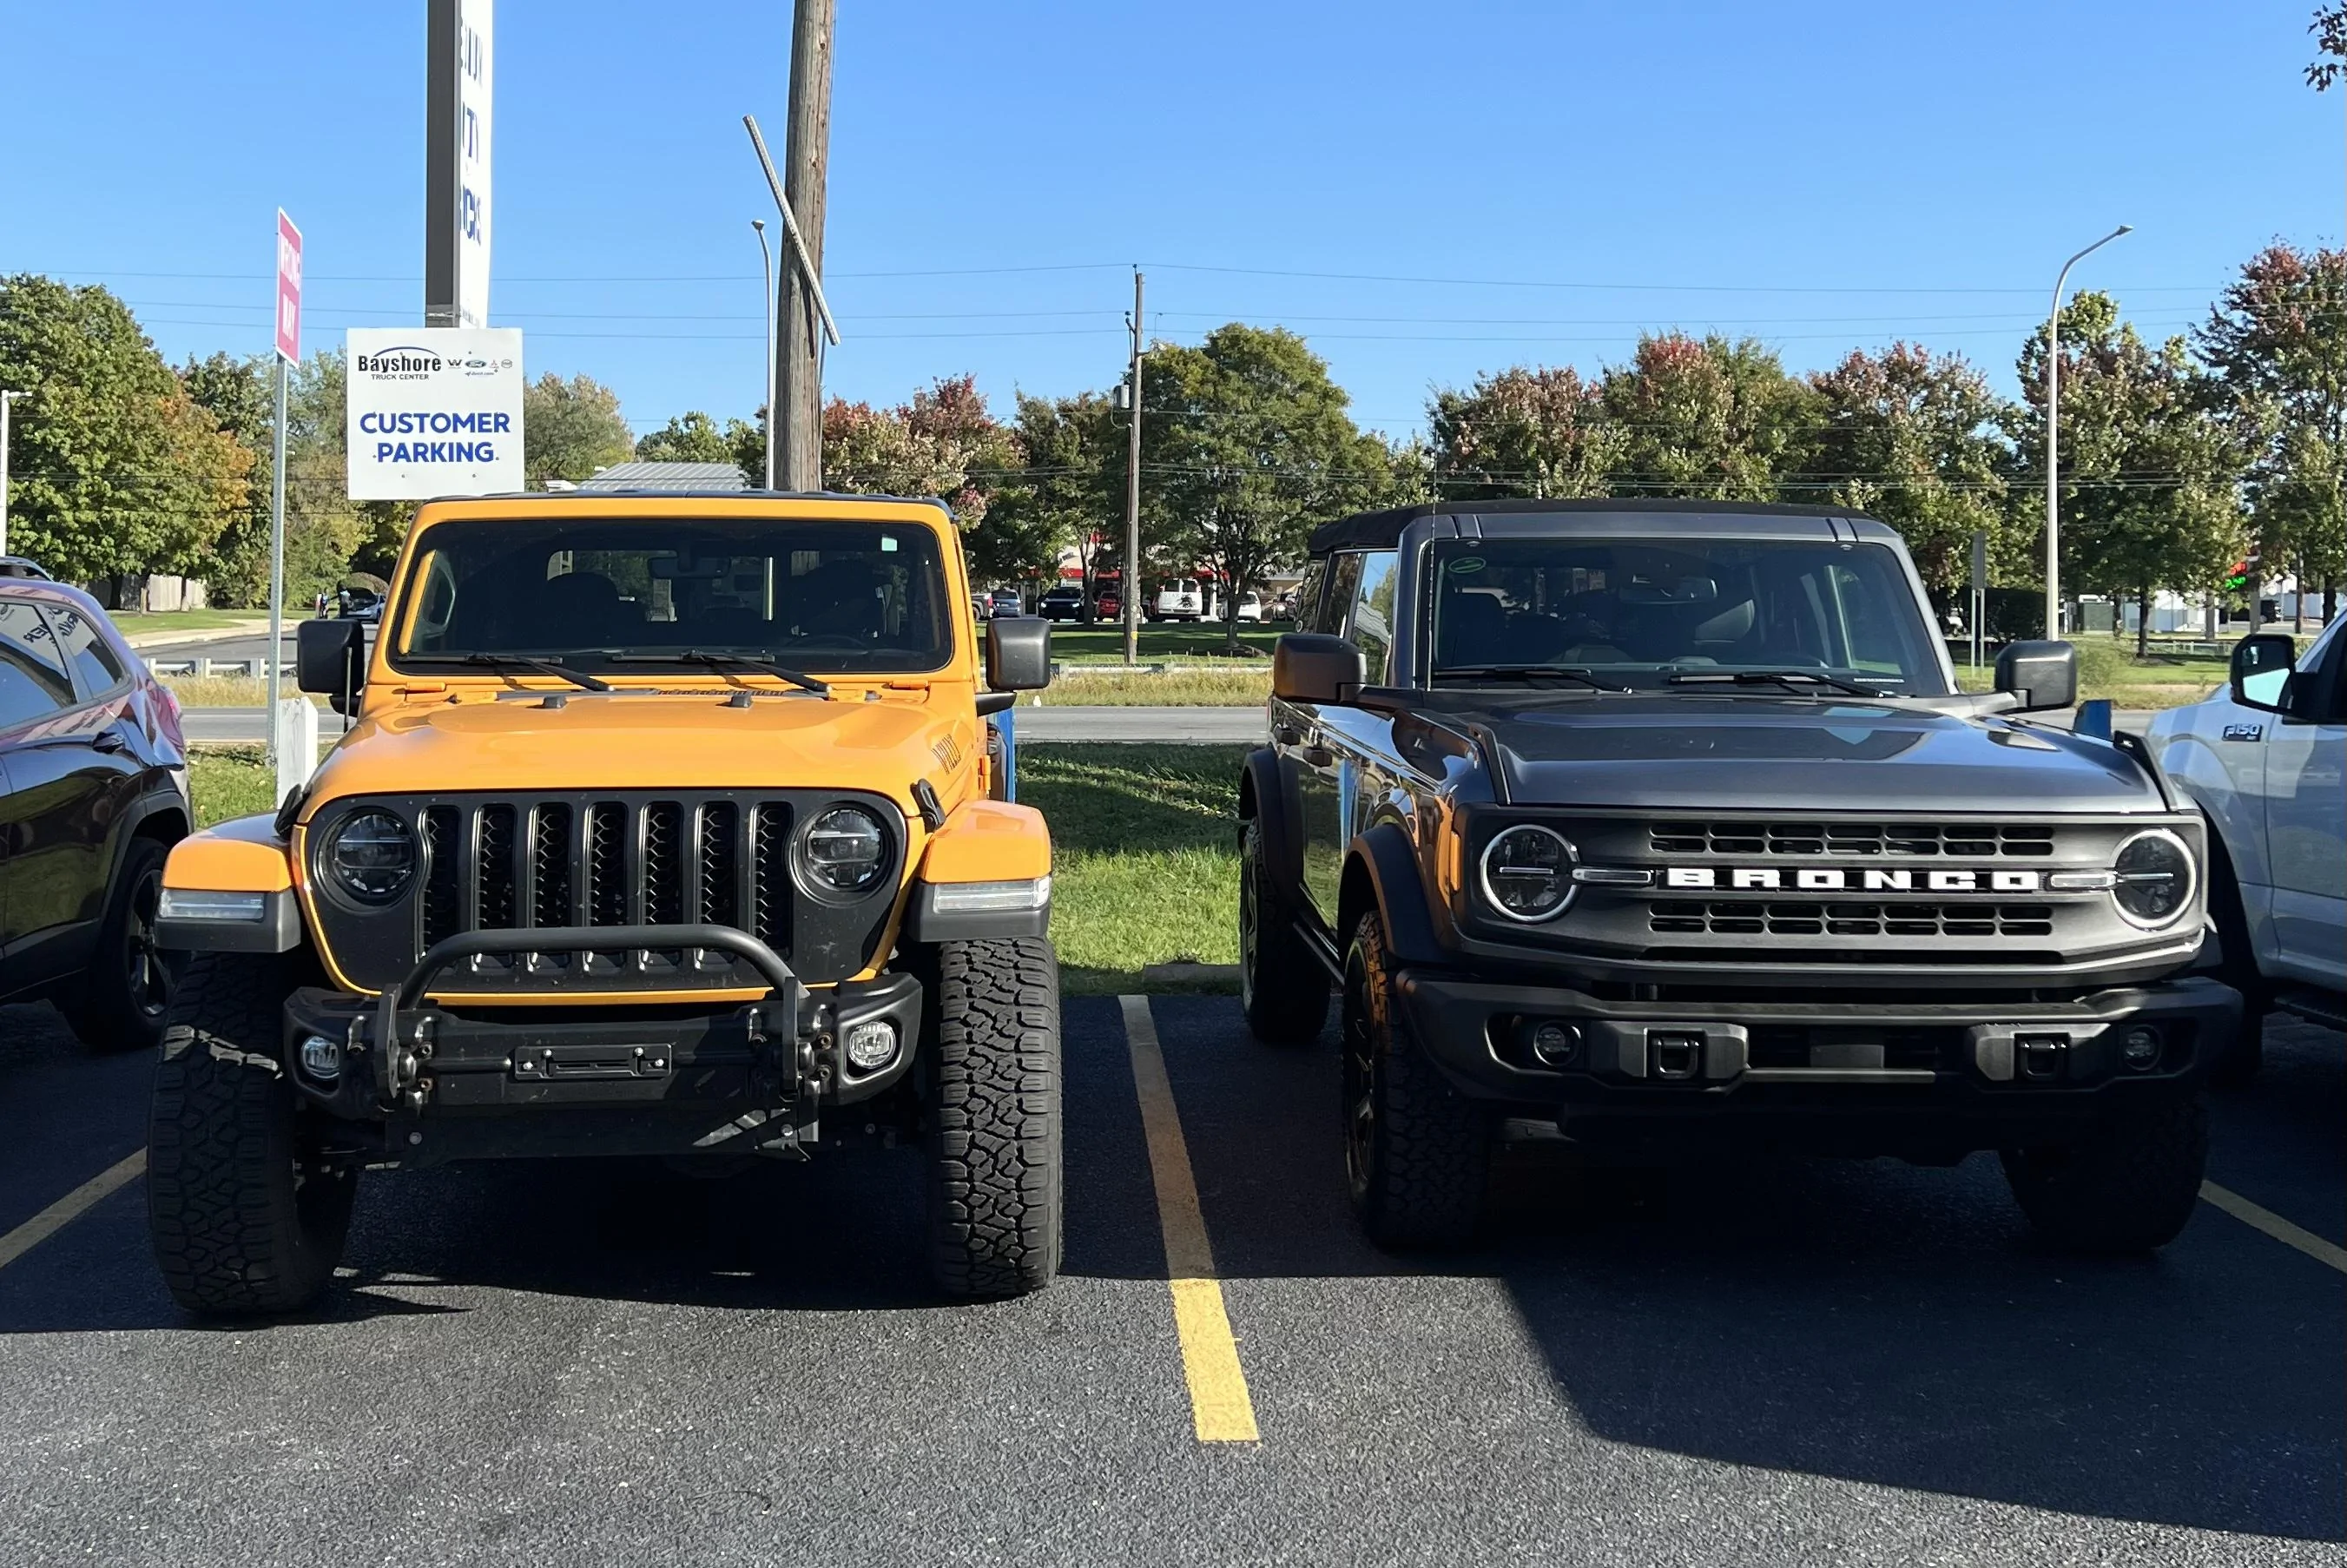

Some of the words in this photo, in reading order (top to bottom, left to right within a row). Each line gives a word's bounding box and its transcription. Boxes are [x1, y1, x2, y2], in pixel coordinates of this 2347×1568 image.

[358, 355, 442, 373] Bayshore
[359, 412, 511, 434] CUSTOMER
[377, 441, 494, 463] PARKING
[1667, 868, 2040, 891] BRONCO
